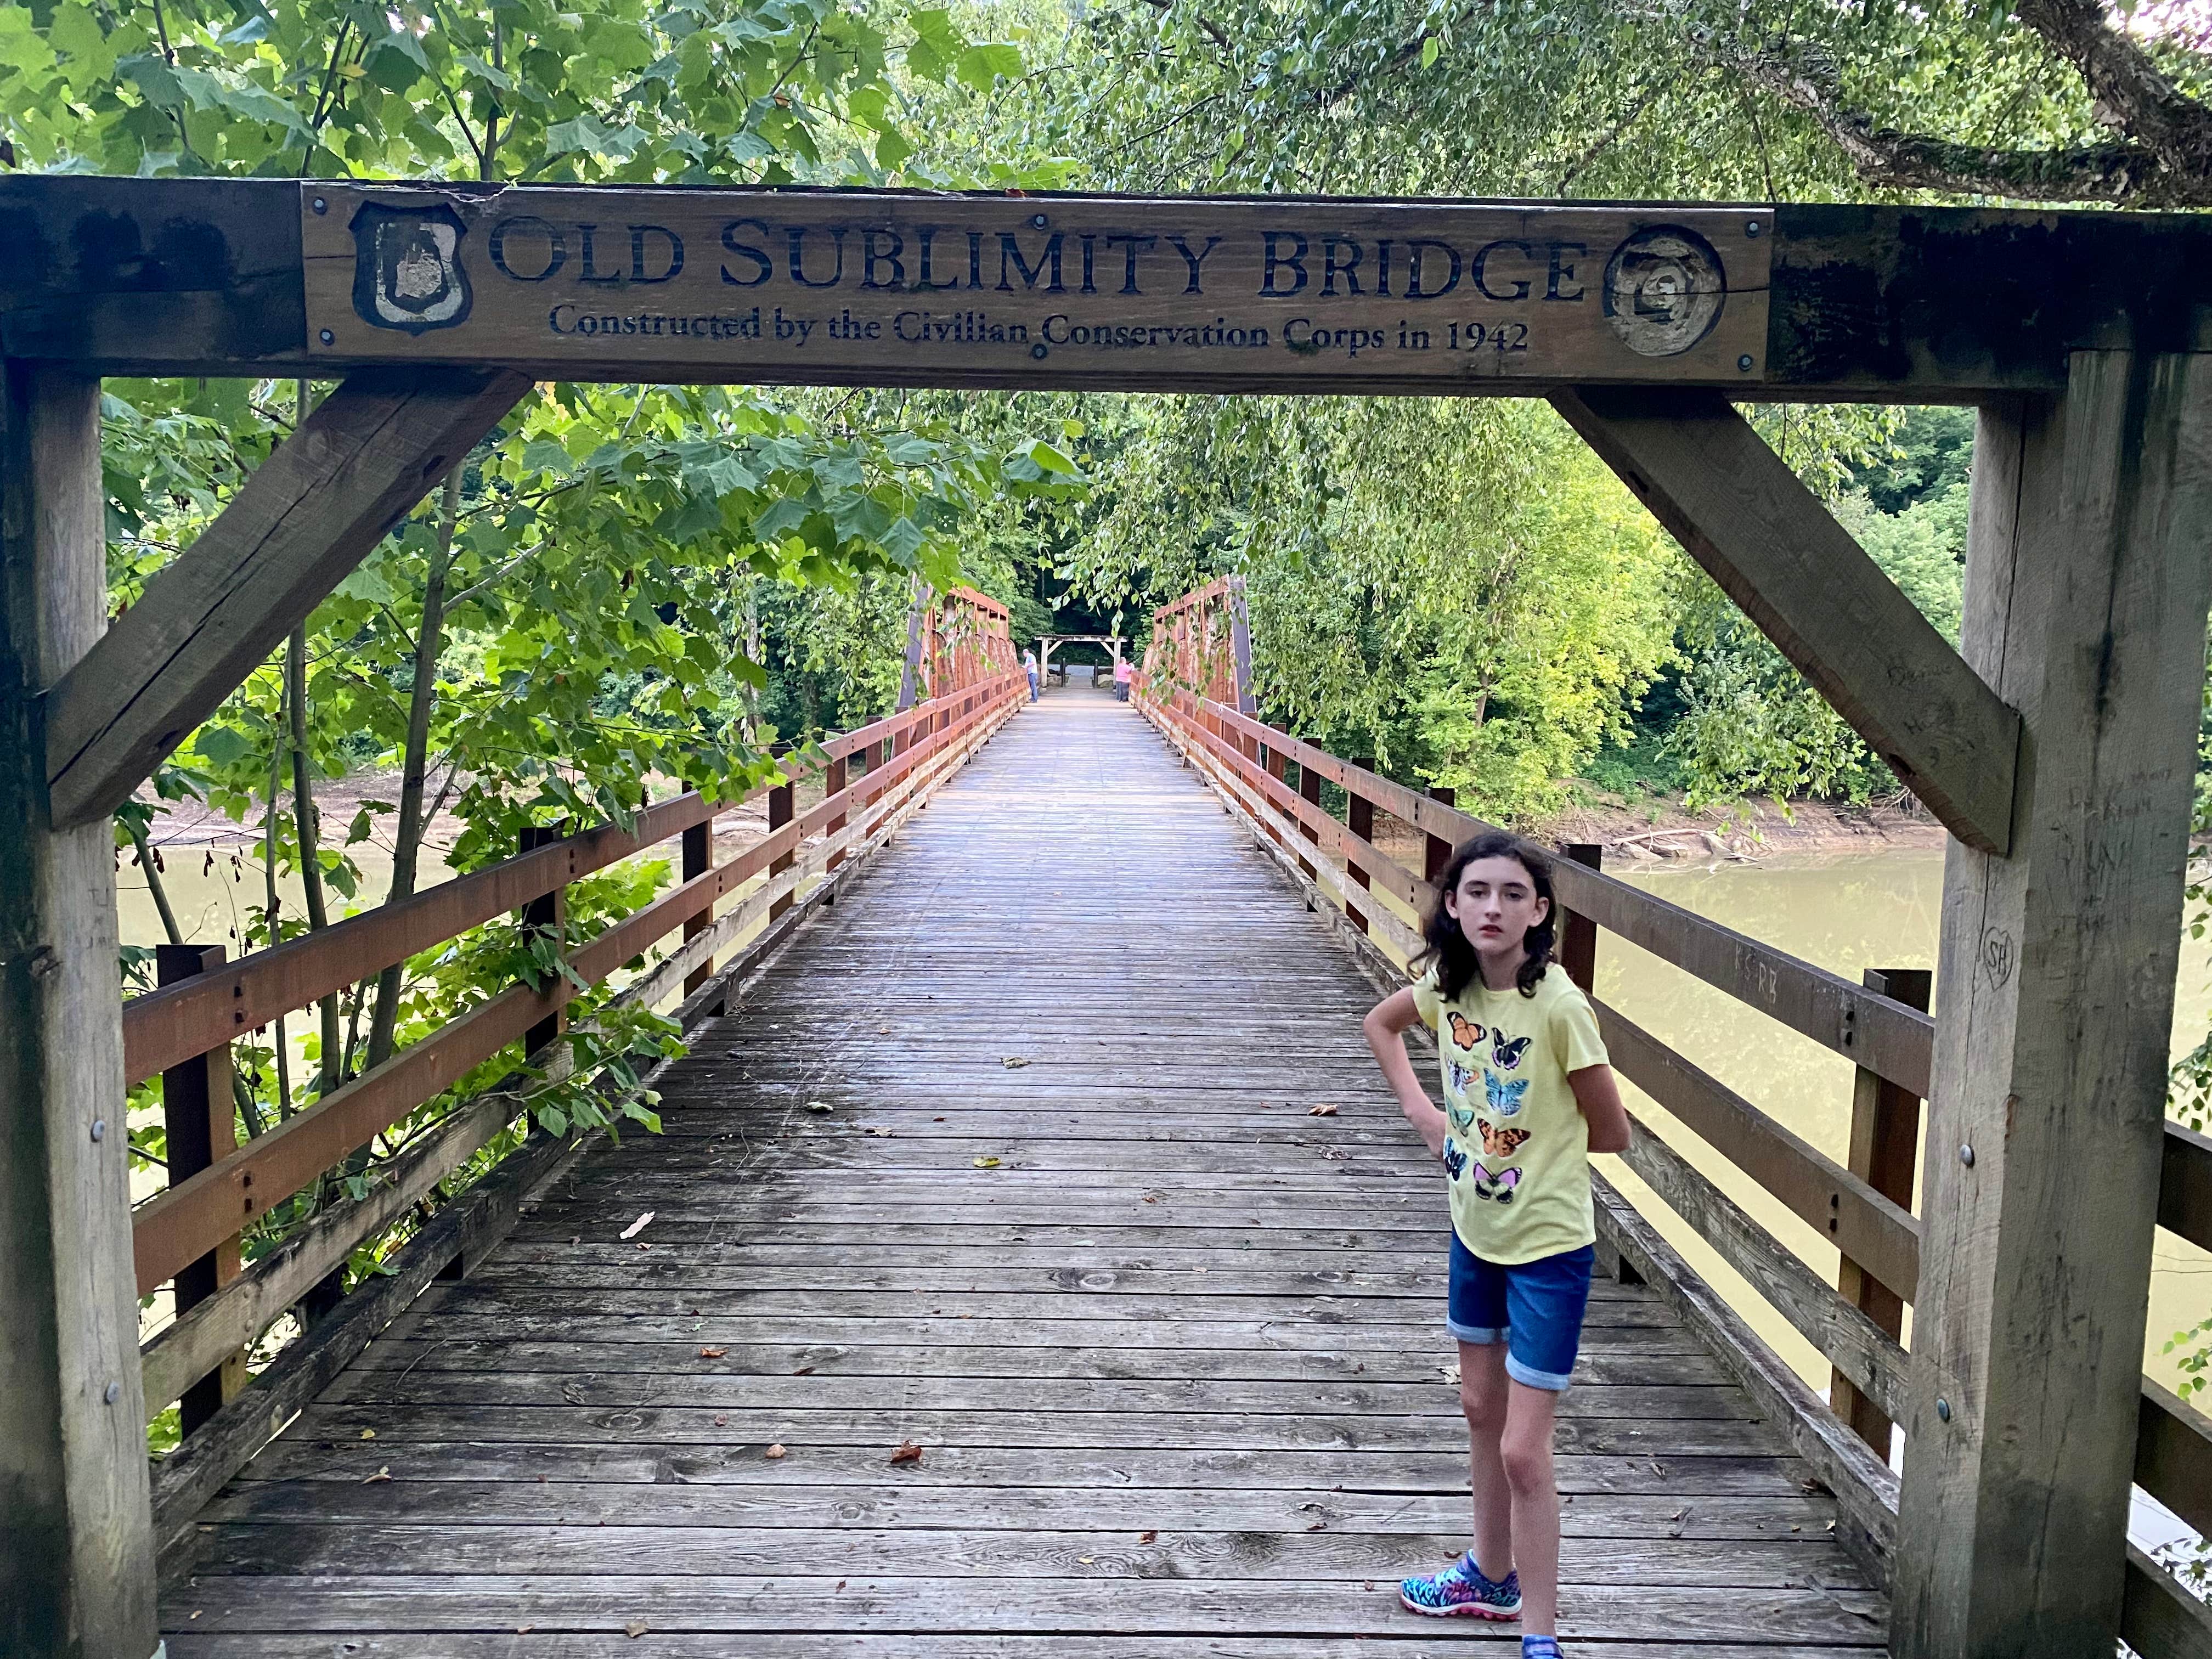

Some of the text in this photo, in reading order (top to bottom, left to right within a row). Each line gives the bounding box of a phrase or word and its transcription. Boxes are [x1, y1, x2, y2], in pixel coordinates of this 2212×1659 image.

[489, 216, 1588, 301] OLD SUBLIMITY BRIDGE
[549, 303, 1529, 358] Constructed by the Civilian Conservation Corps in 1942
[1988, 934, 2010, 975] SH
